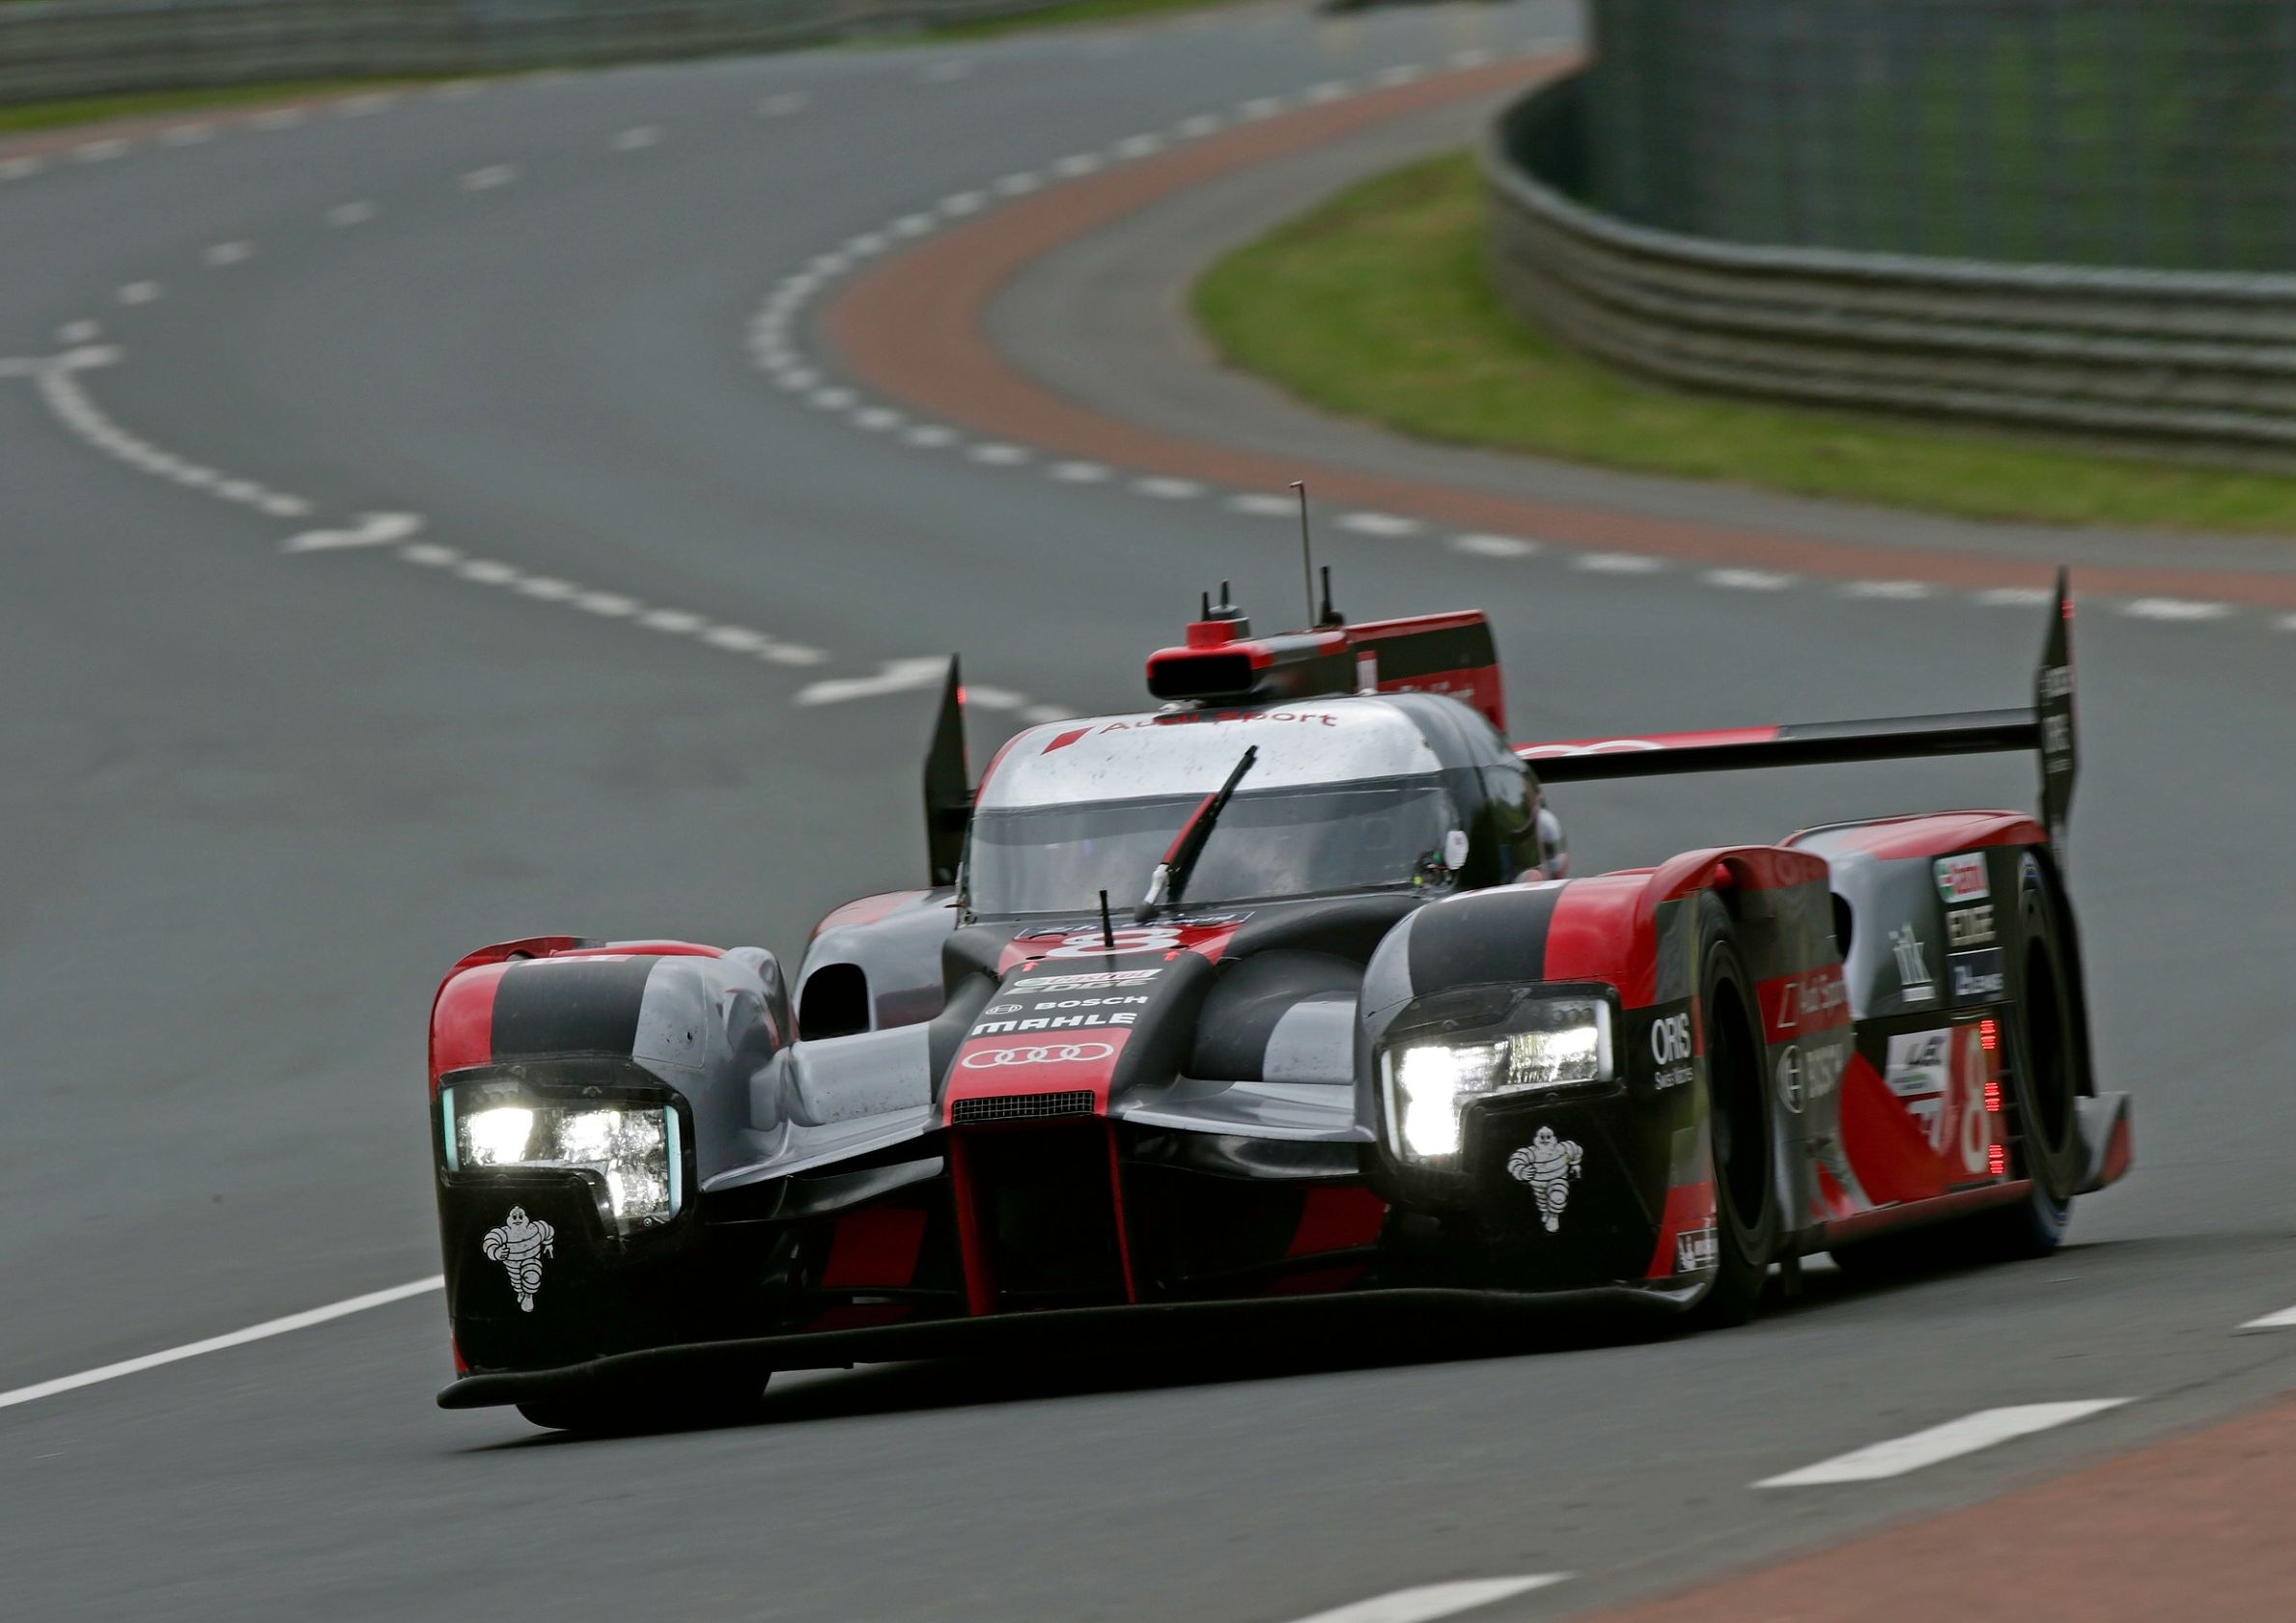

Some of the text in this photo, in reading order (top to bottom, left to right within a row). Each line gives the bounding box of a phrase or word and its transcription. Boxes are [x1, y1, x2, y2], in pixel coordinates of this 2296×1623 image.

[1098, 710, 1339, 735] Audi Sport
[1045, 927, 1183, 958] 8
[1003, 978, 1159, 995] EDGE
[1034, 995, 1149, 1010] BOSCH
[971, 1012, 1138, 1036] MAHLE
[1651, 1013, 1692, 1065] ORIS
[1961, 1027, 1992, 1174] 8
